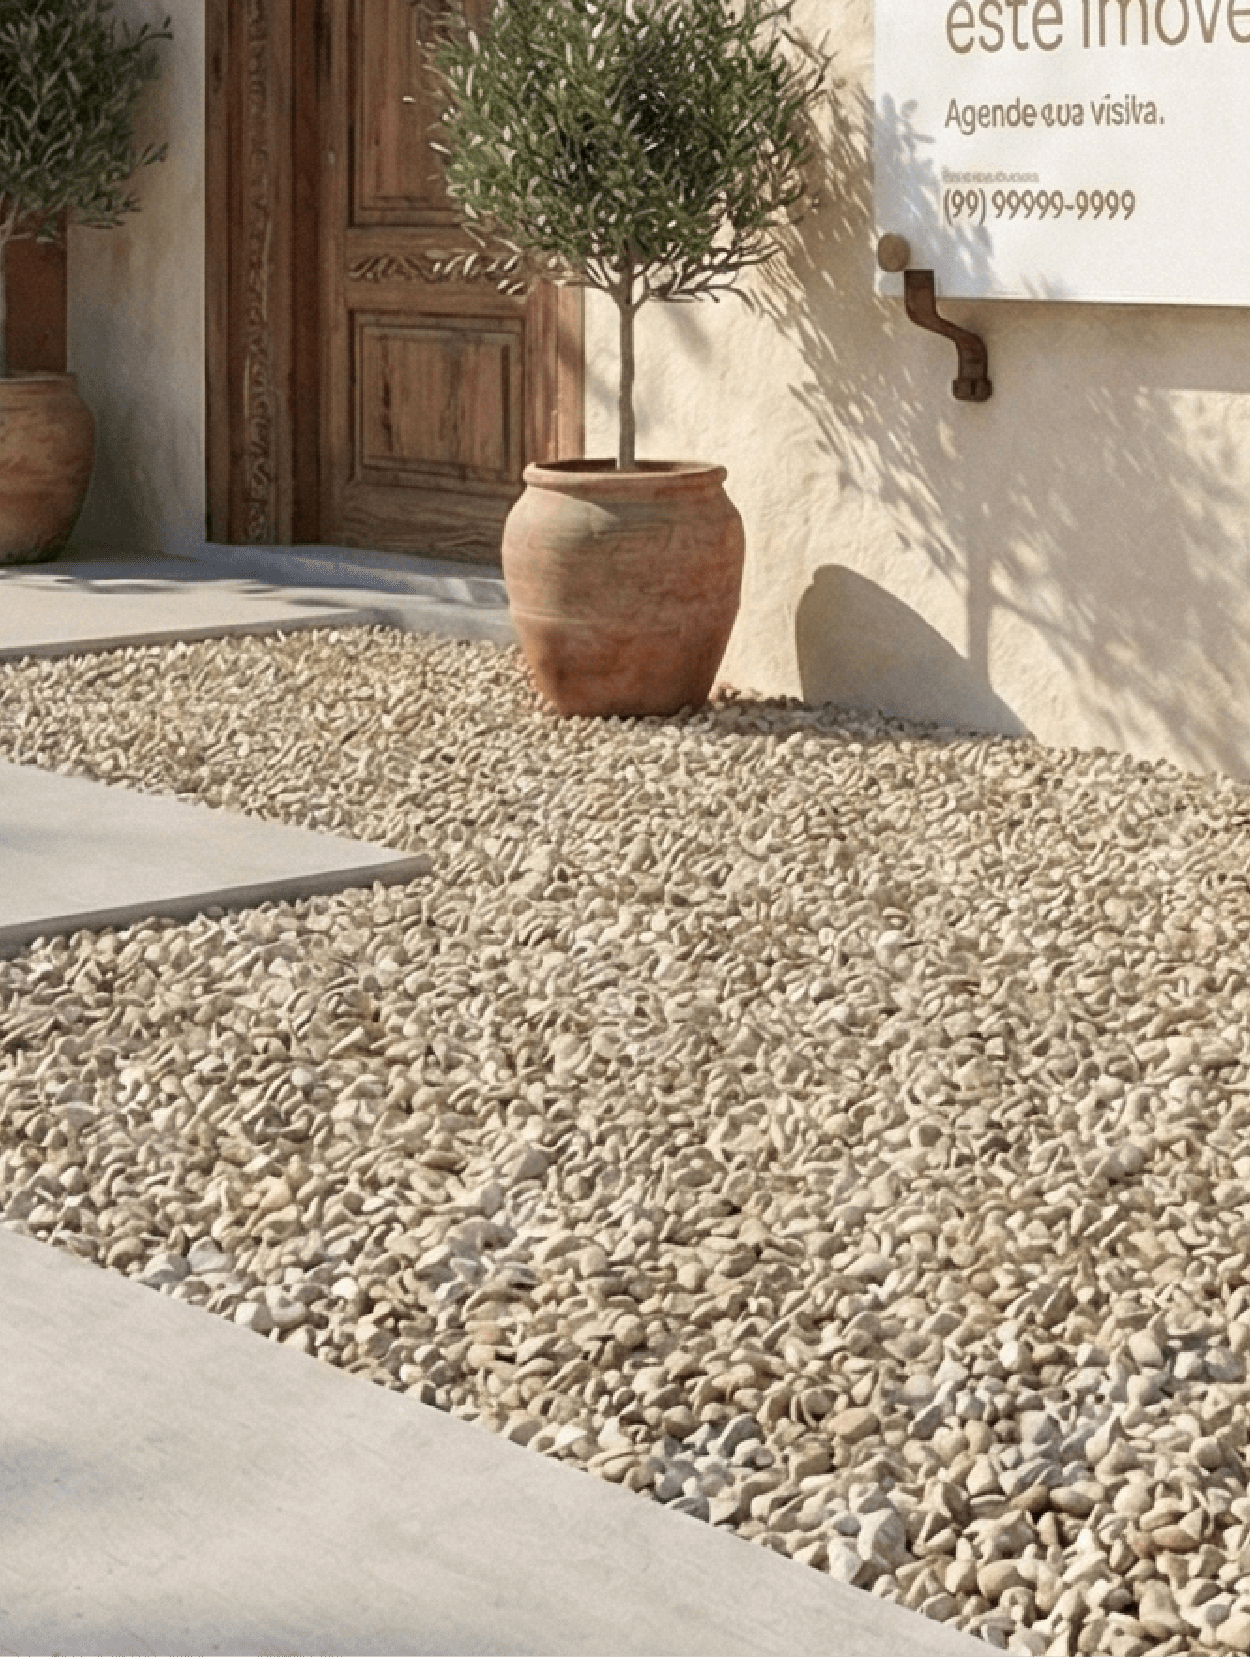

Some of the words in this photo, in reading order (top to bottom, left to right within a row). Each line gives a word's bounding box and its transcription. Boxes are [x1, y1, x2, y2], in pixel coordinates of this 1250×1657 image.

[944, 96, 1038, 136] Agende
[943, 188, 988, 228] (99)
[991, 189, 1136, 221] 99999-9999
